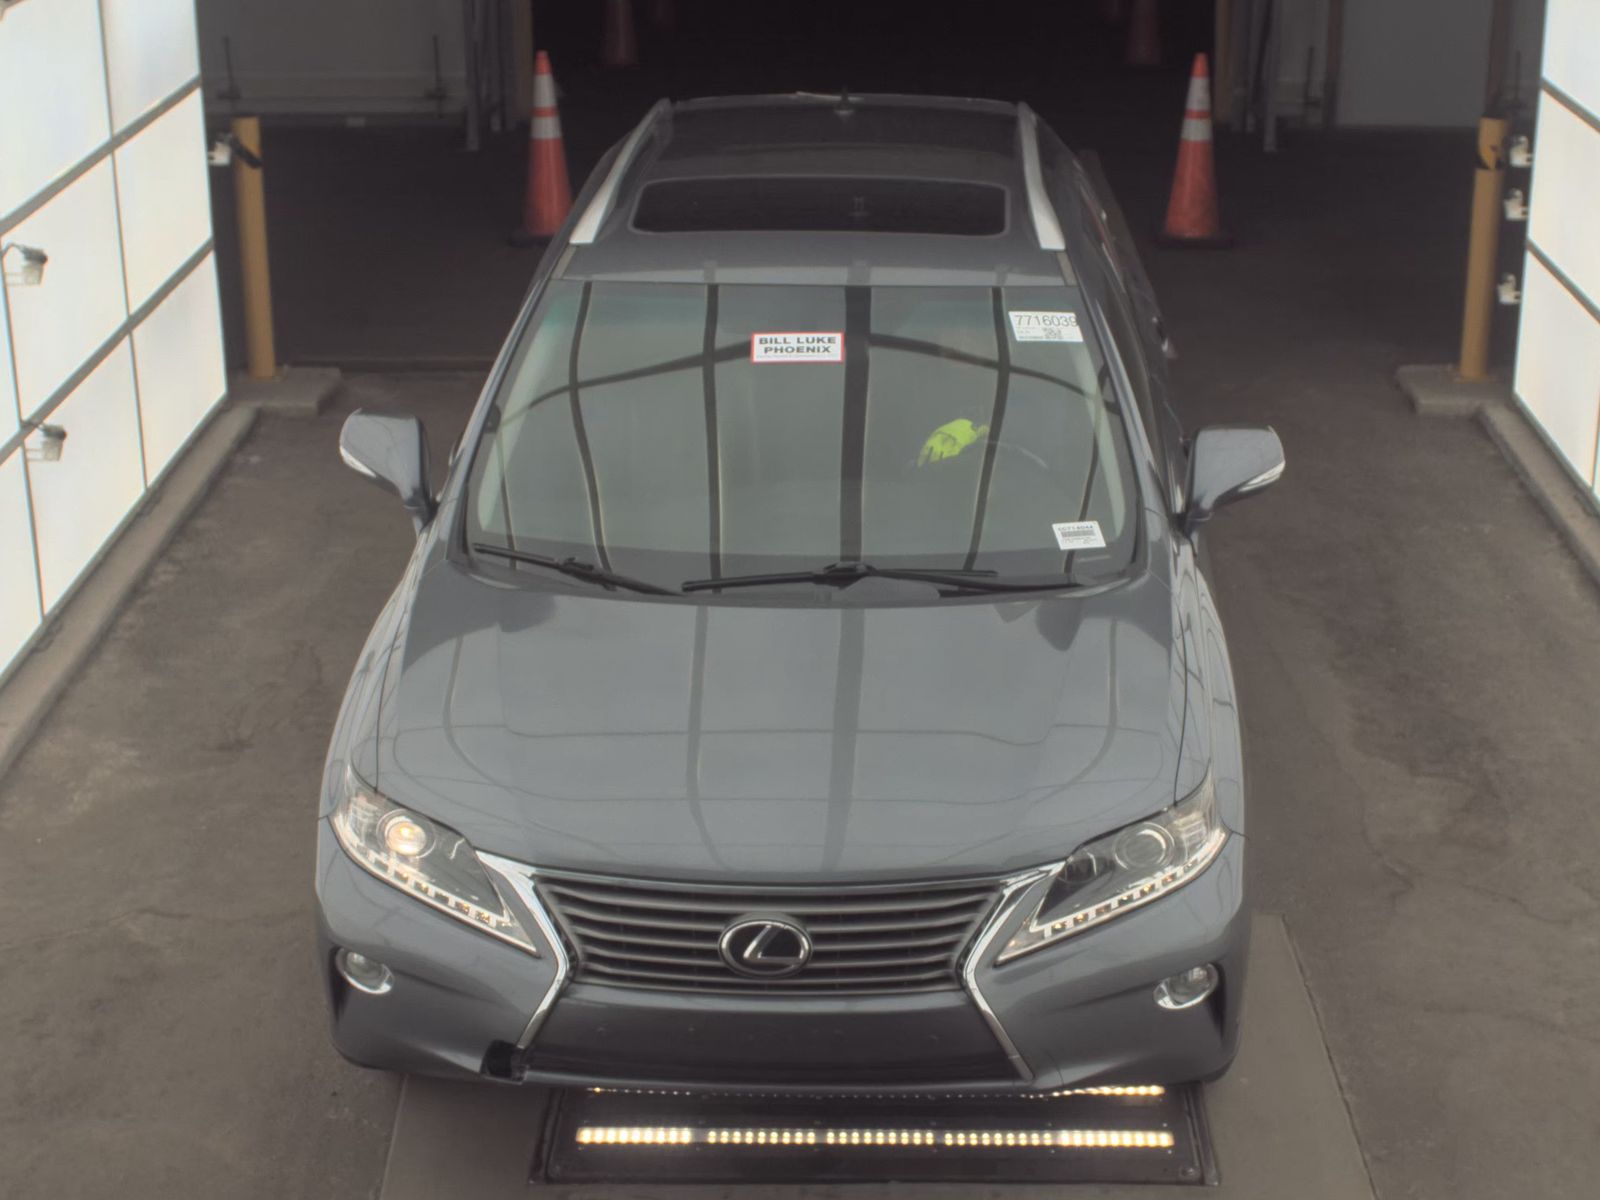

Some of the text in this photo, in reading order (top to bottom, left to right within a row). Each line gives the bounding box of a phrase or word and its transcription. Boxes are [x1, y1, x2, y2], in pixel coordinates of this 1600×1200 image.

[759, 336, 837, 345] BILL LUKE
[763, 345, 832, 354] PHOENIX
